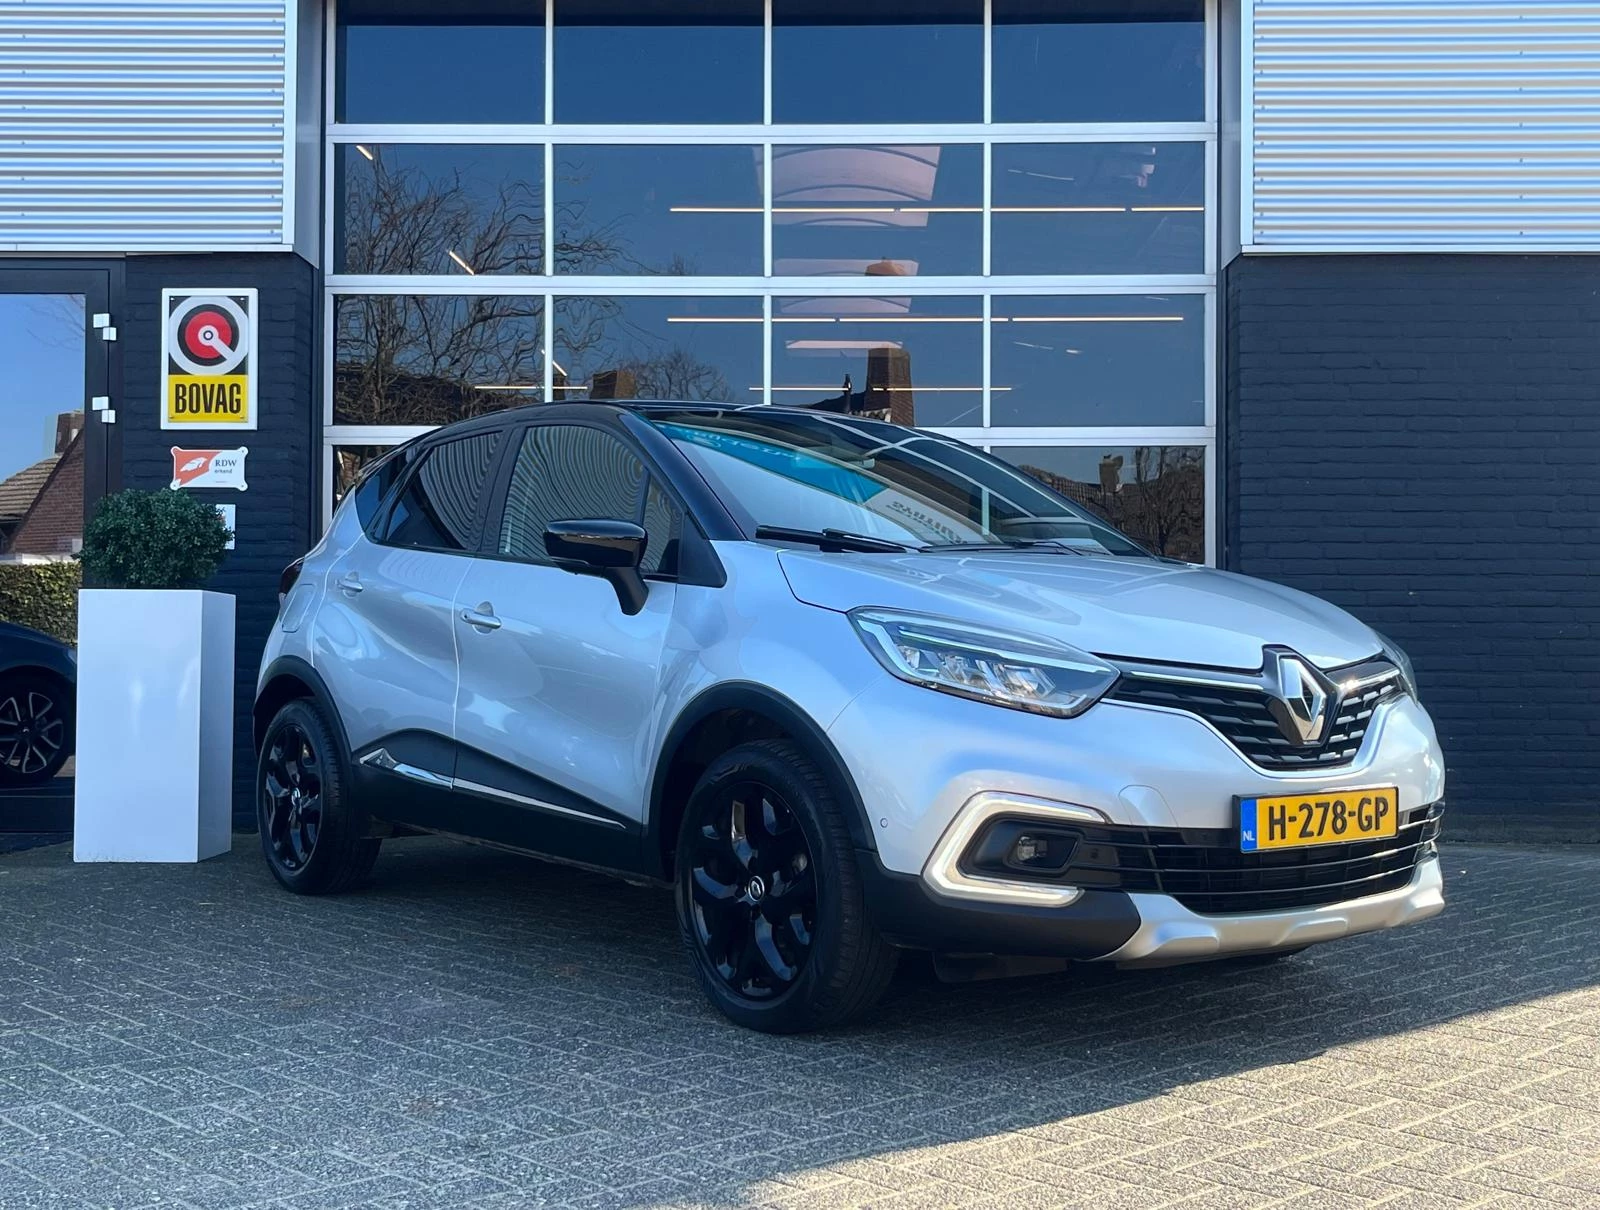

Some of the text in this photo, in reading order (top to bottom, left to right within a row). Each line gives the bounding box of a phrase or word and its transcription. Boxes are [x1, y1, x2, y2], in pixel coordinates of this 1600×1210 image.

[175, 383, 241, 414] BOVAG
[215, 459, 237, 467] RDW
[1269, 797, 1388, 841] H-278-GP
[1243, 831, 1255, 841] NL
